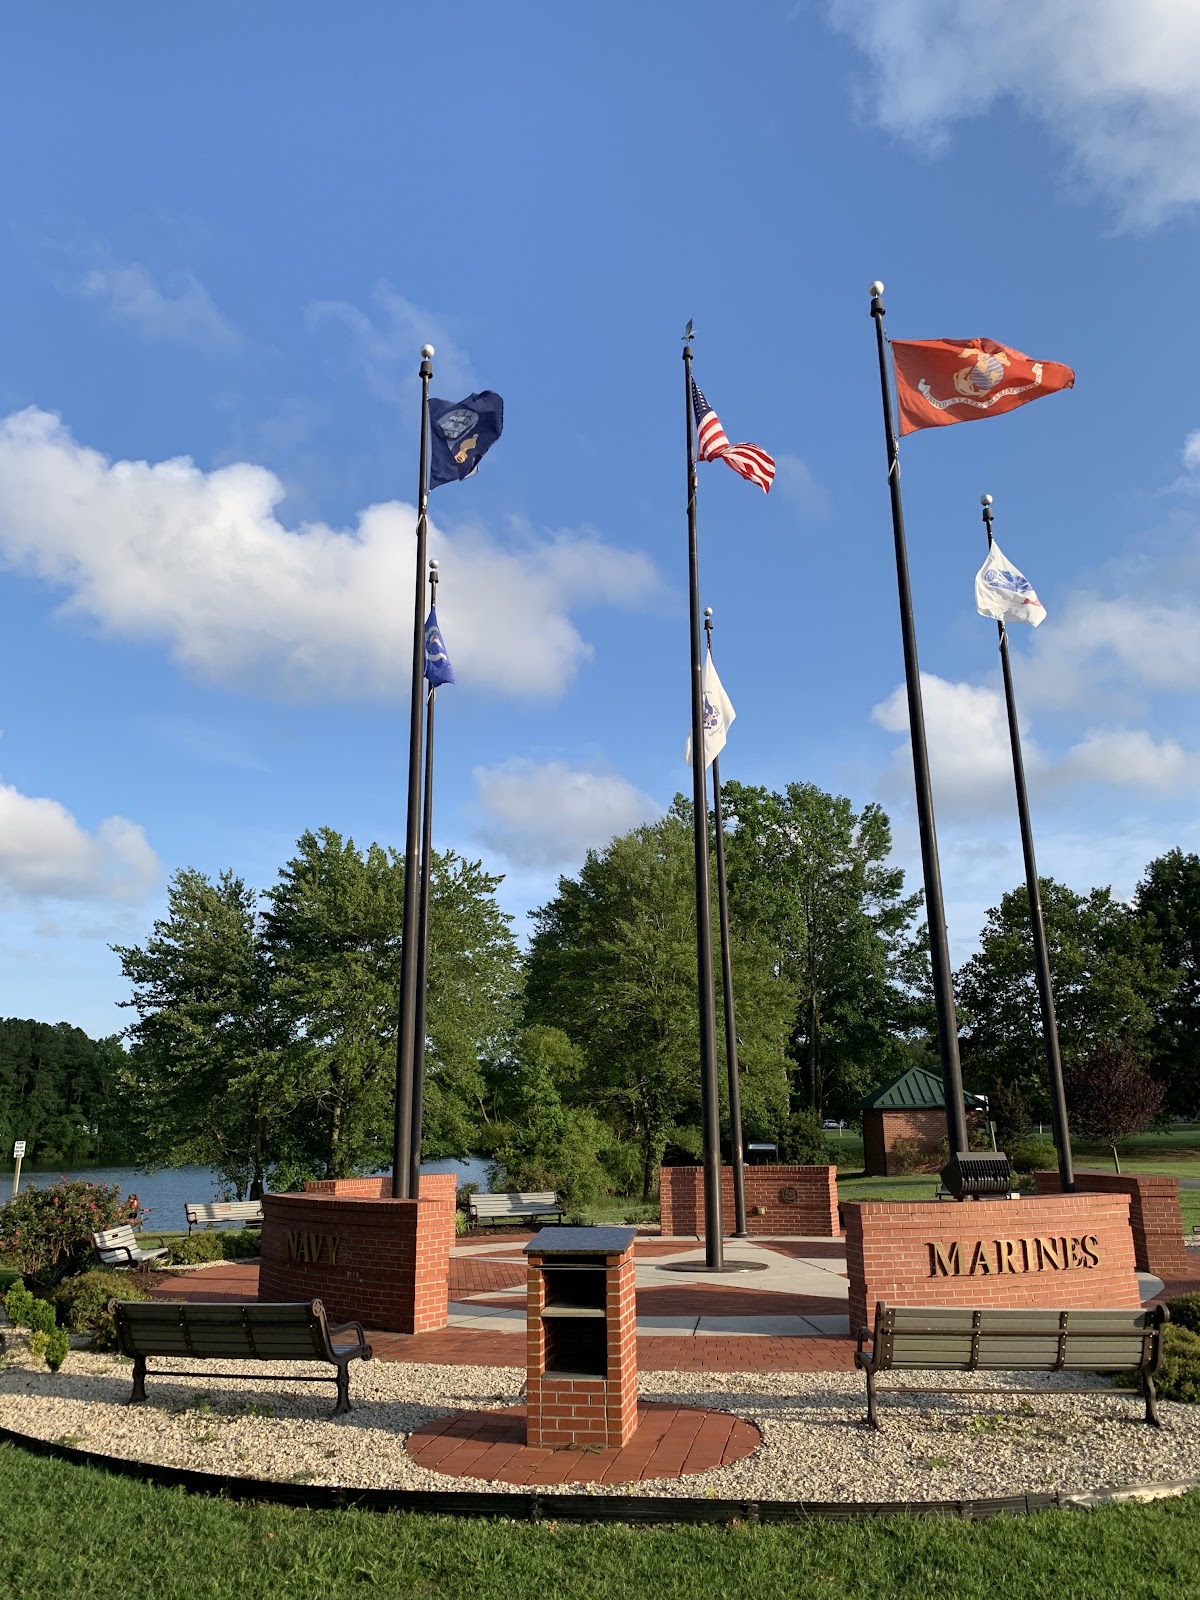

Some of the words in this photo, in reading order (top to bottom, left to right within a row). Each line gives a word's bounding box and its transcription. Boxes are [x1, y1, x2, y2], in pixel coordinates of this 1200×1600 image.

[924, 391, 947, 408] UNITED
[951, 398, 984, 408] STATES
[987, 388, 1015, 405] MARINE
[287, 1229, 340, 1266] NAVY
[925, 1234, 1099, 1278] MARINES
